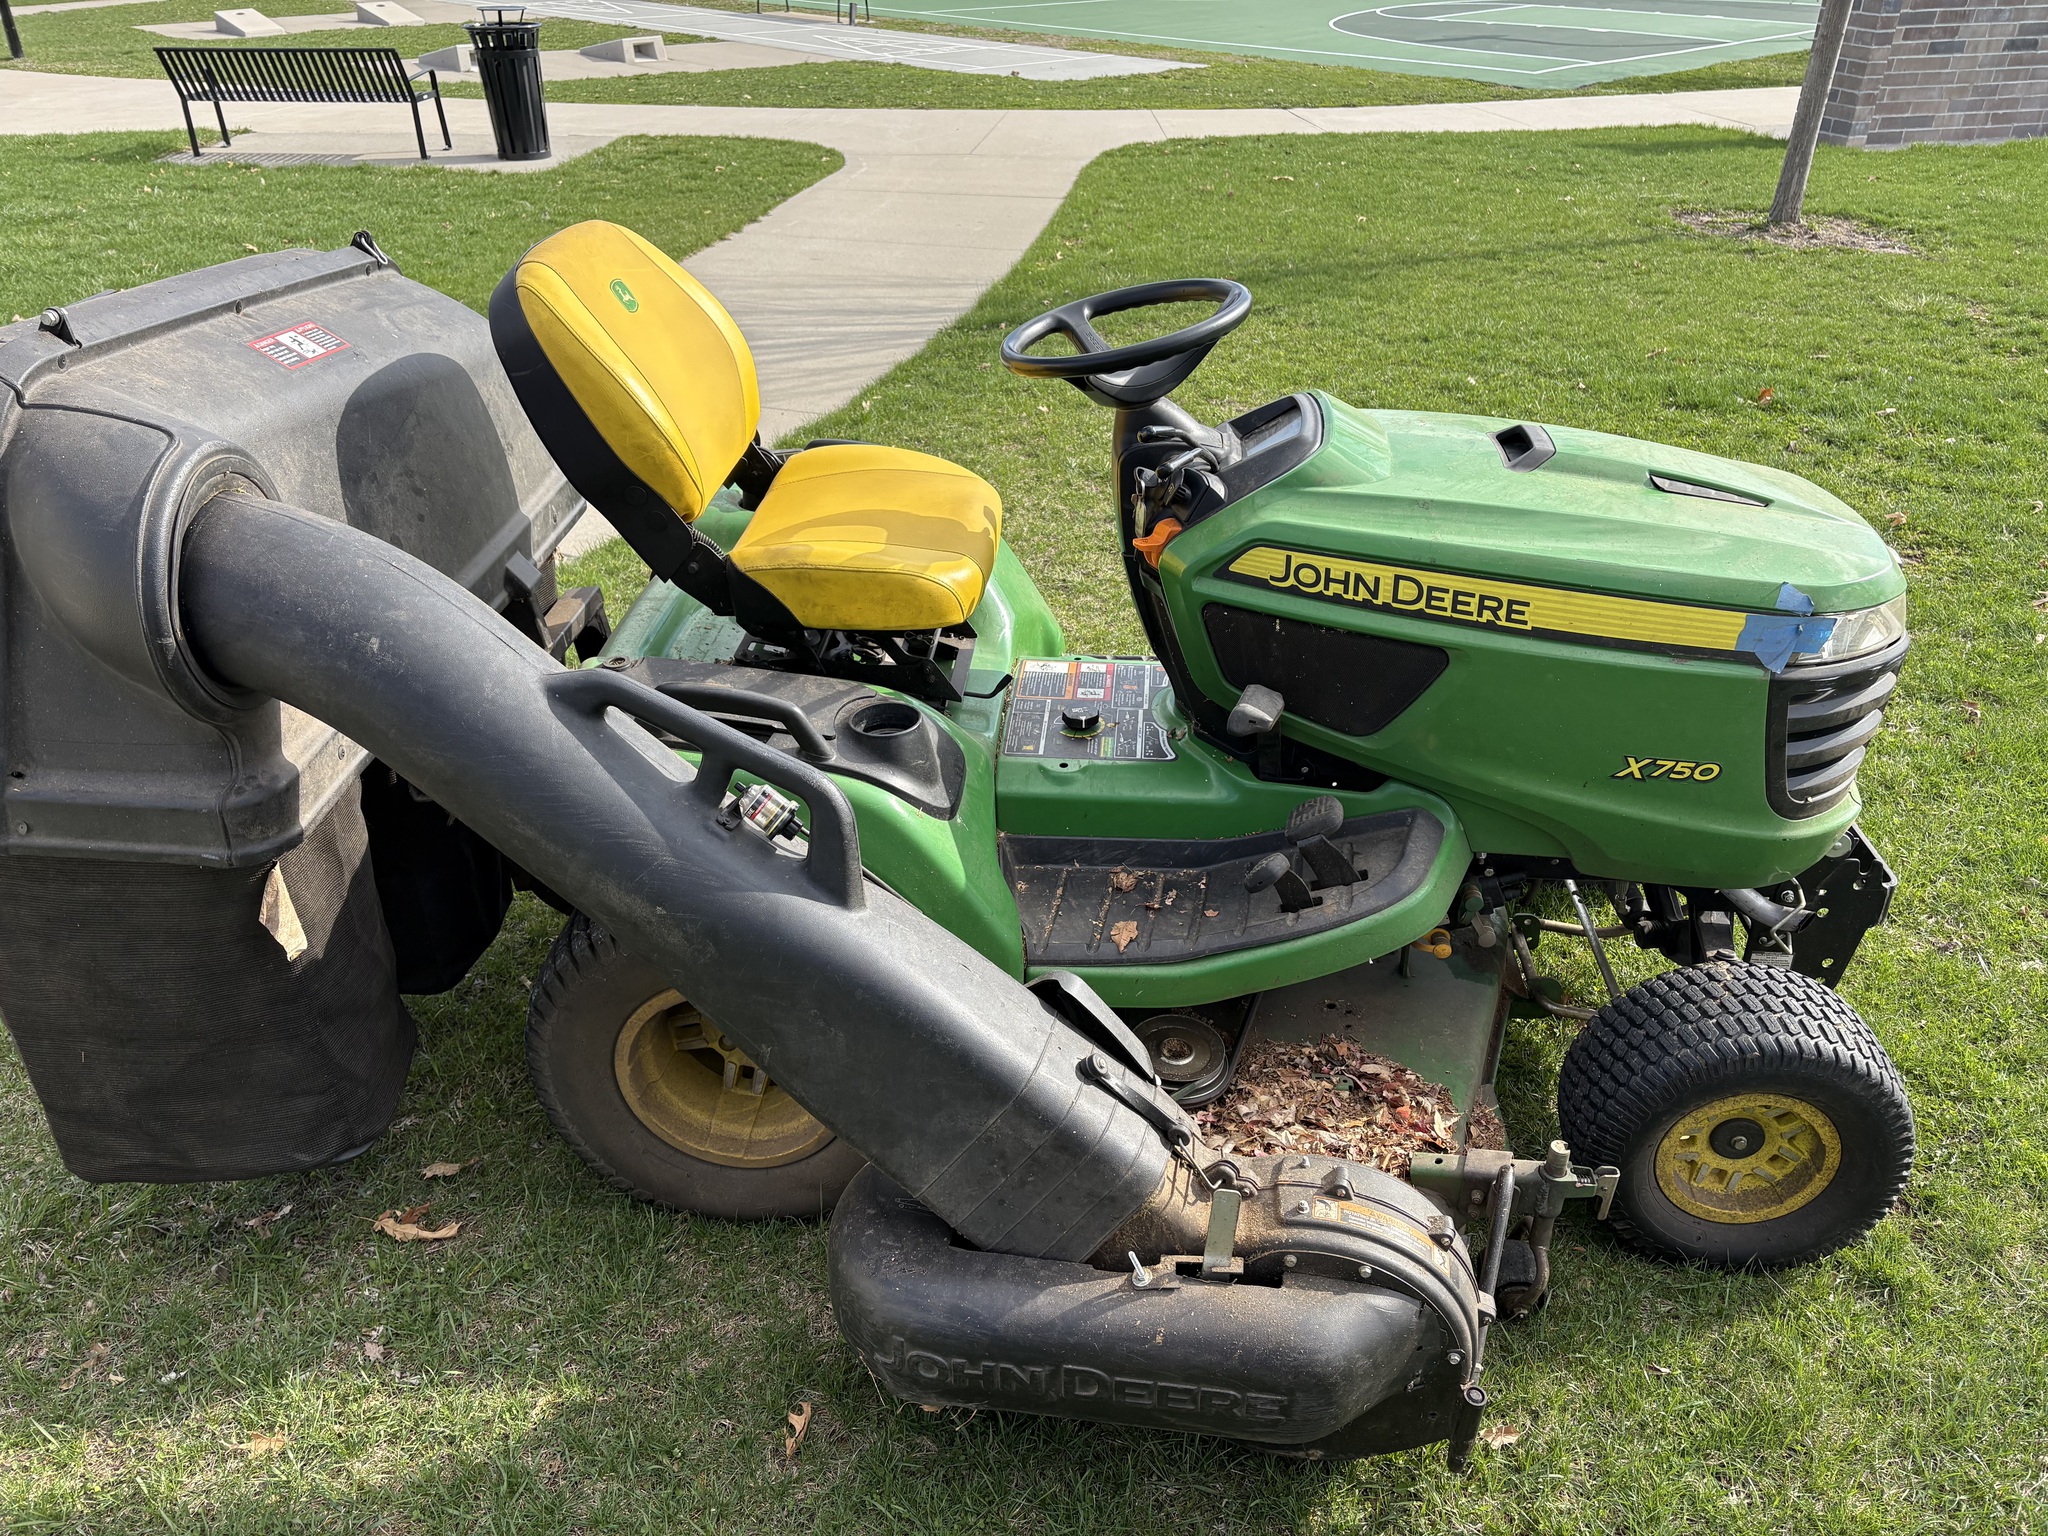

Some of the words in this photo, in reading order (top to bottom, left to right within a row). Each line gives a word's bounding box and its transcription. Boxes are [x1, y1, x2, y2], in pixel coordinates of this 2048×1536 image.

[1269, 554, 1381, 601] JOHN
[1391, 574, 1531, 626] DEERE
[1611, 757, 1721, 782] X750
[873, 1336, 1048, 1395] JOHN
[1061, 1364, 1289, 1421] DEERE
